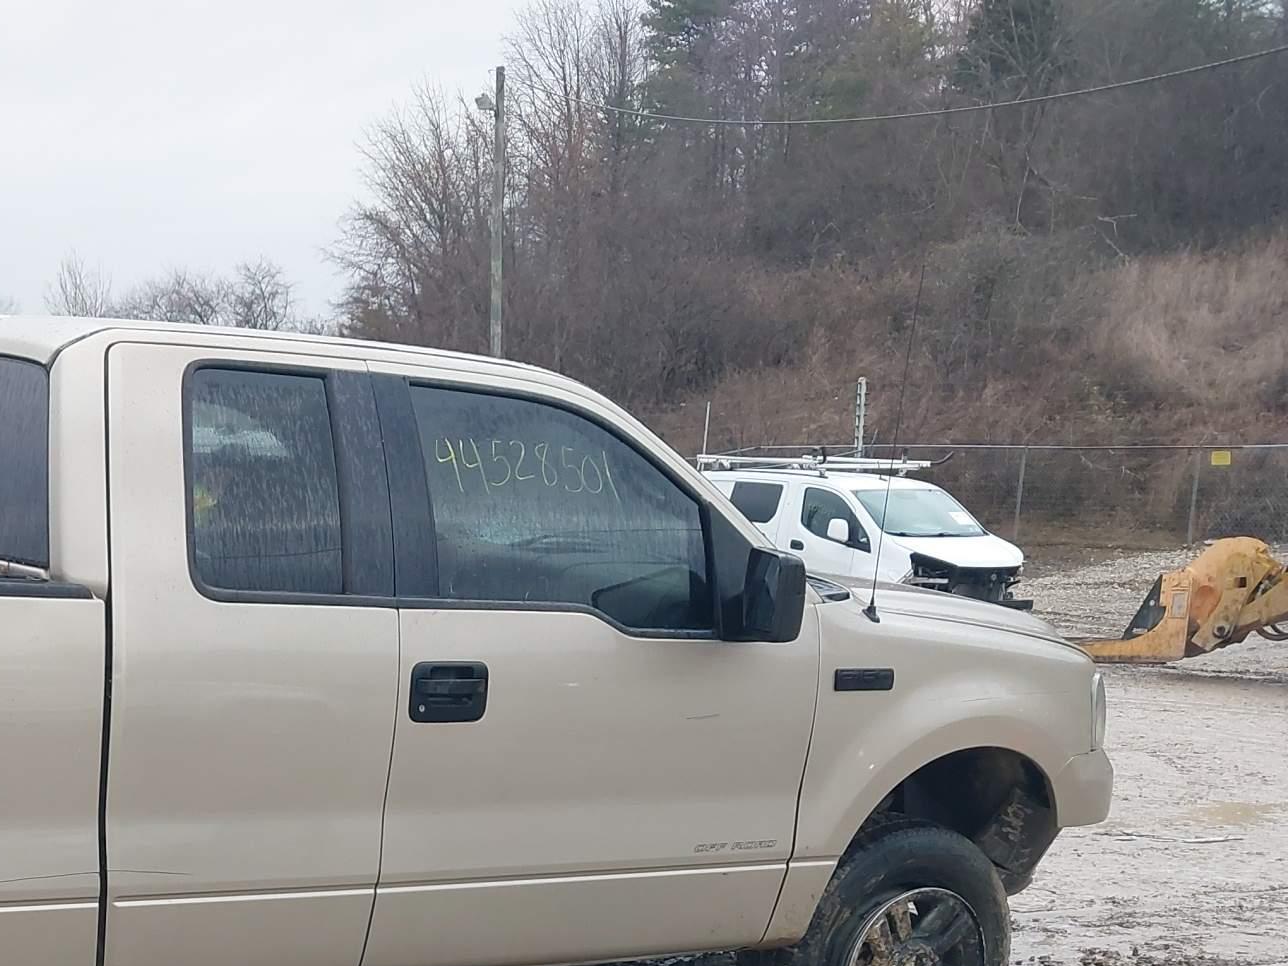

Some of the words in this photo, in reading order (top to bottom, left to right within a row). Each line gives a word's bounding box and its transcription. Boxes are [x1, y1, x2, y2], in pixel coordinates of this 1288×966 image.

[435, 437, 621, 504] 44528501
[694, 842, 728, 853] OFF
[731, 840, 778, 850] ROAD
